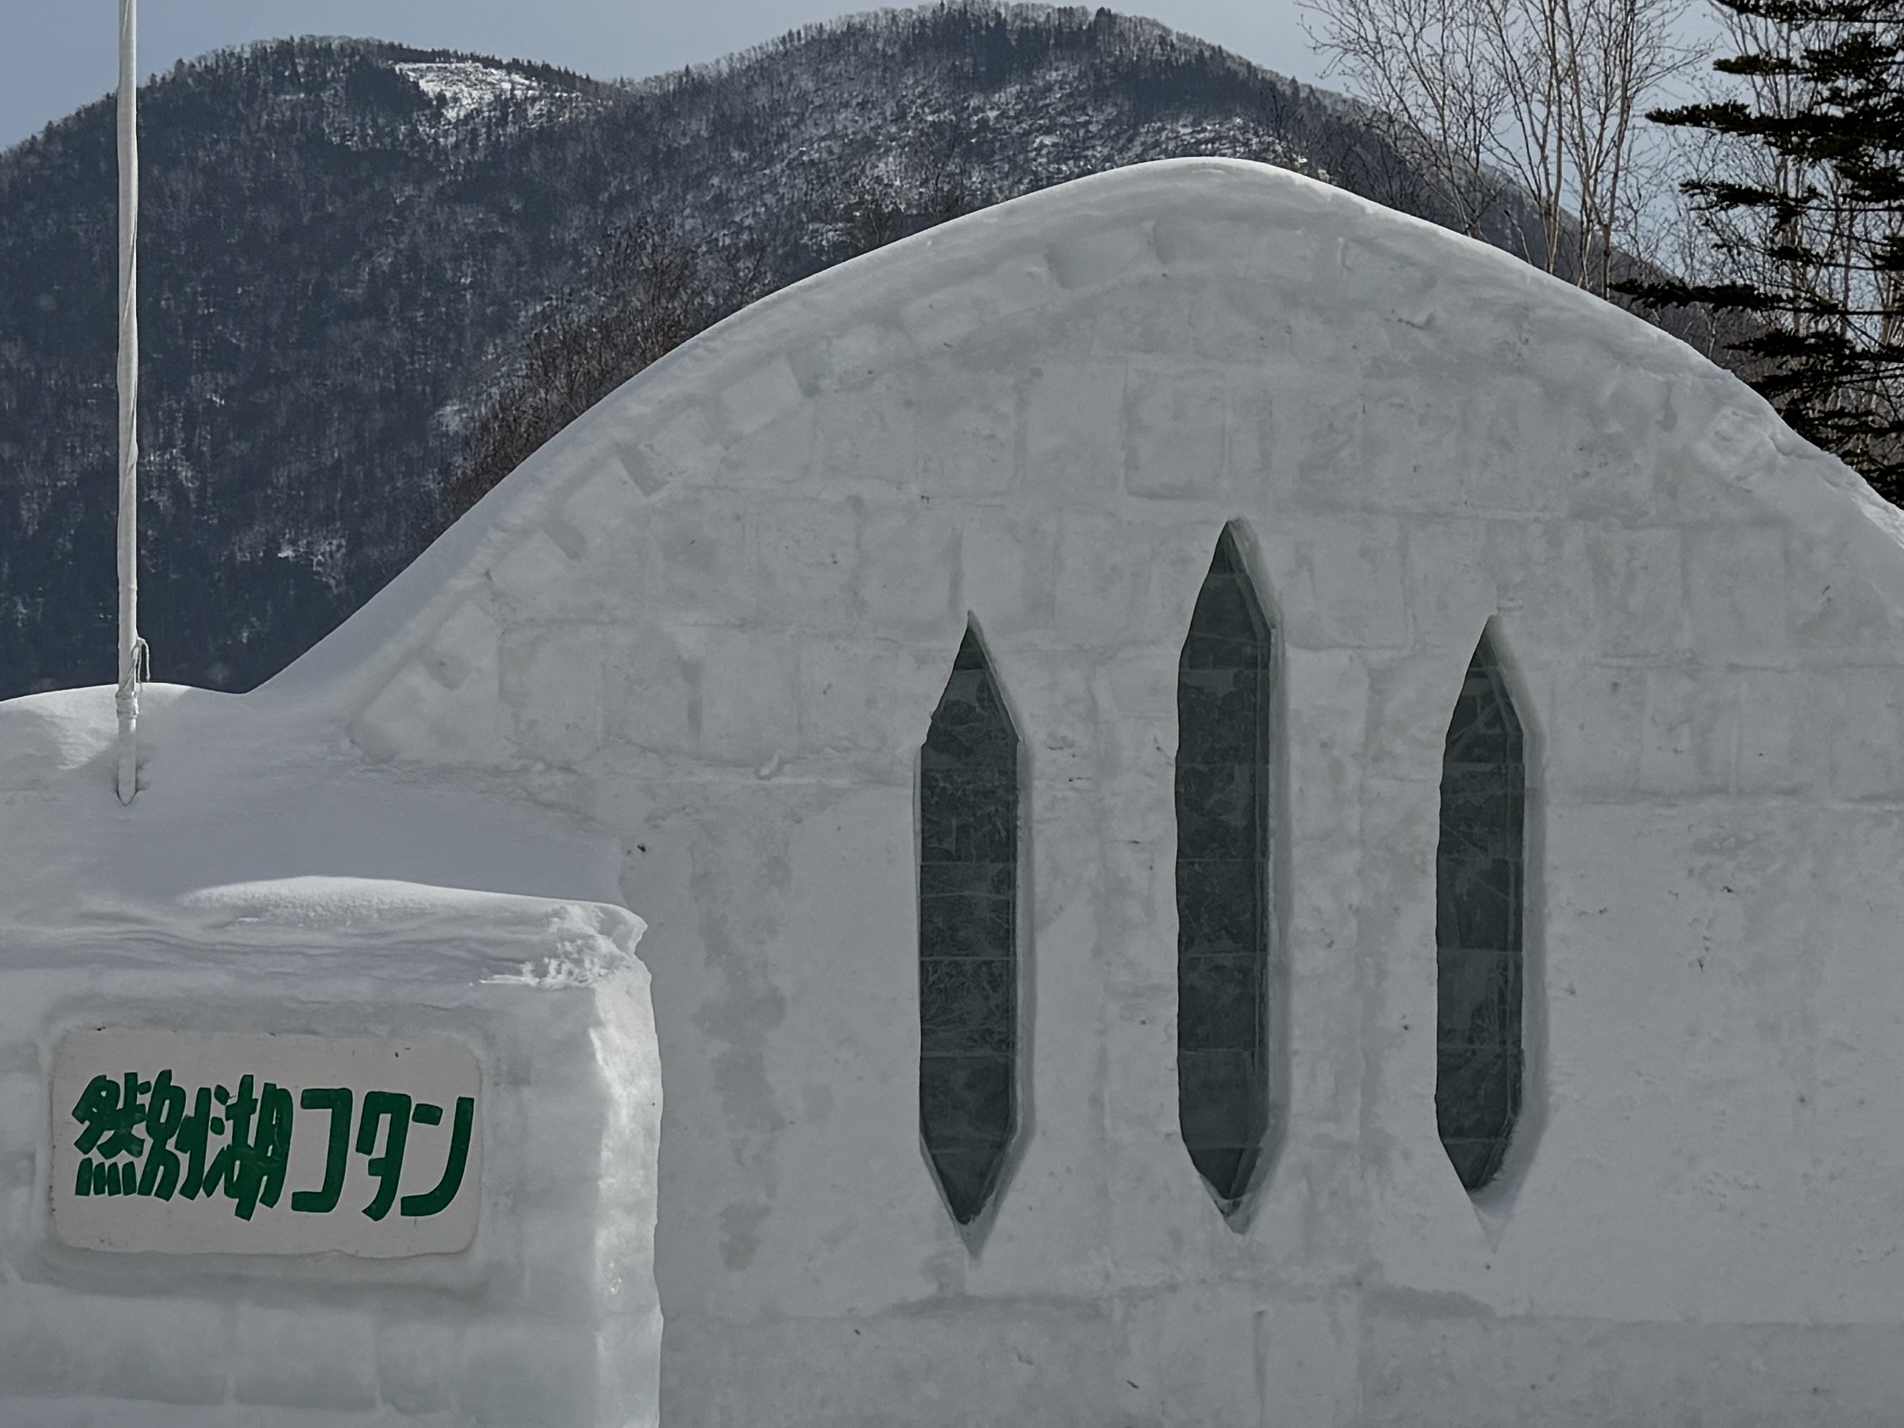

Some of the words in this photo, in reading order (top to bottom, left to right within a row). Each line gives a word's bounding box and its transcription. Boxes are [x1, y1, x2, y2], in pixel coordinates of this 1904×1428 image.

[71, 1069, 475, 1221] 然別湖コタン
